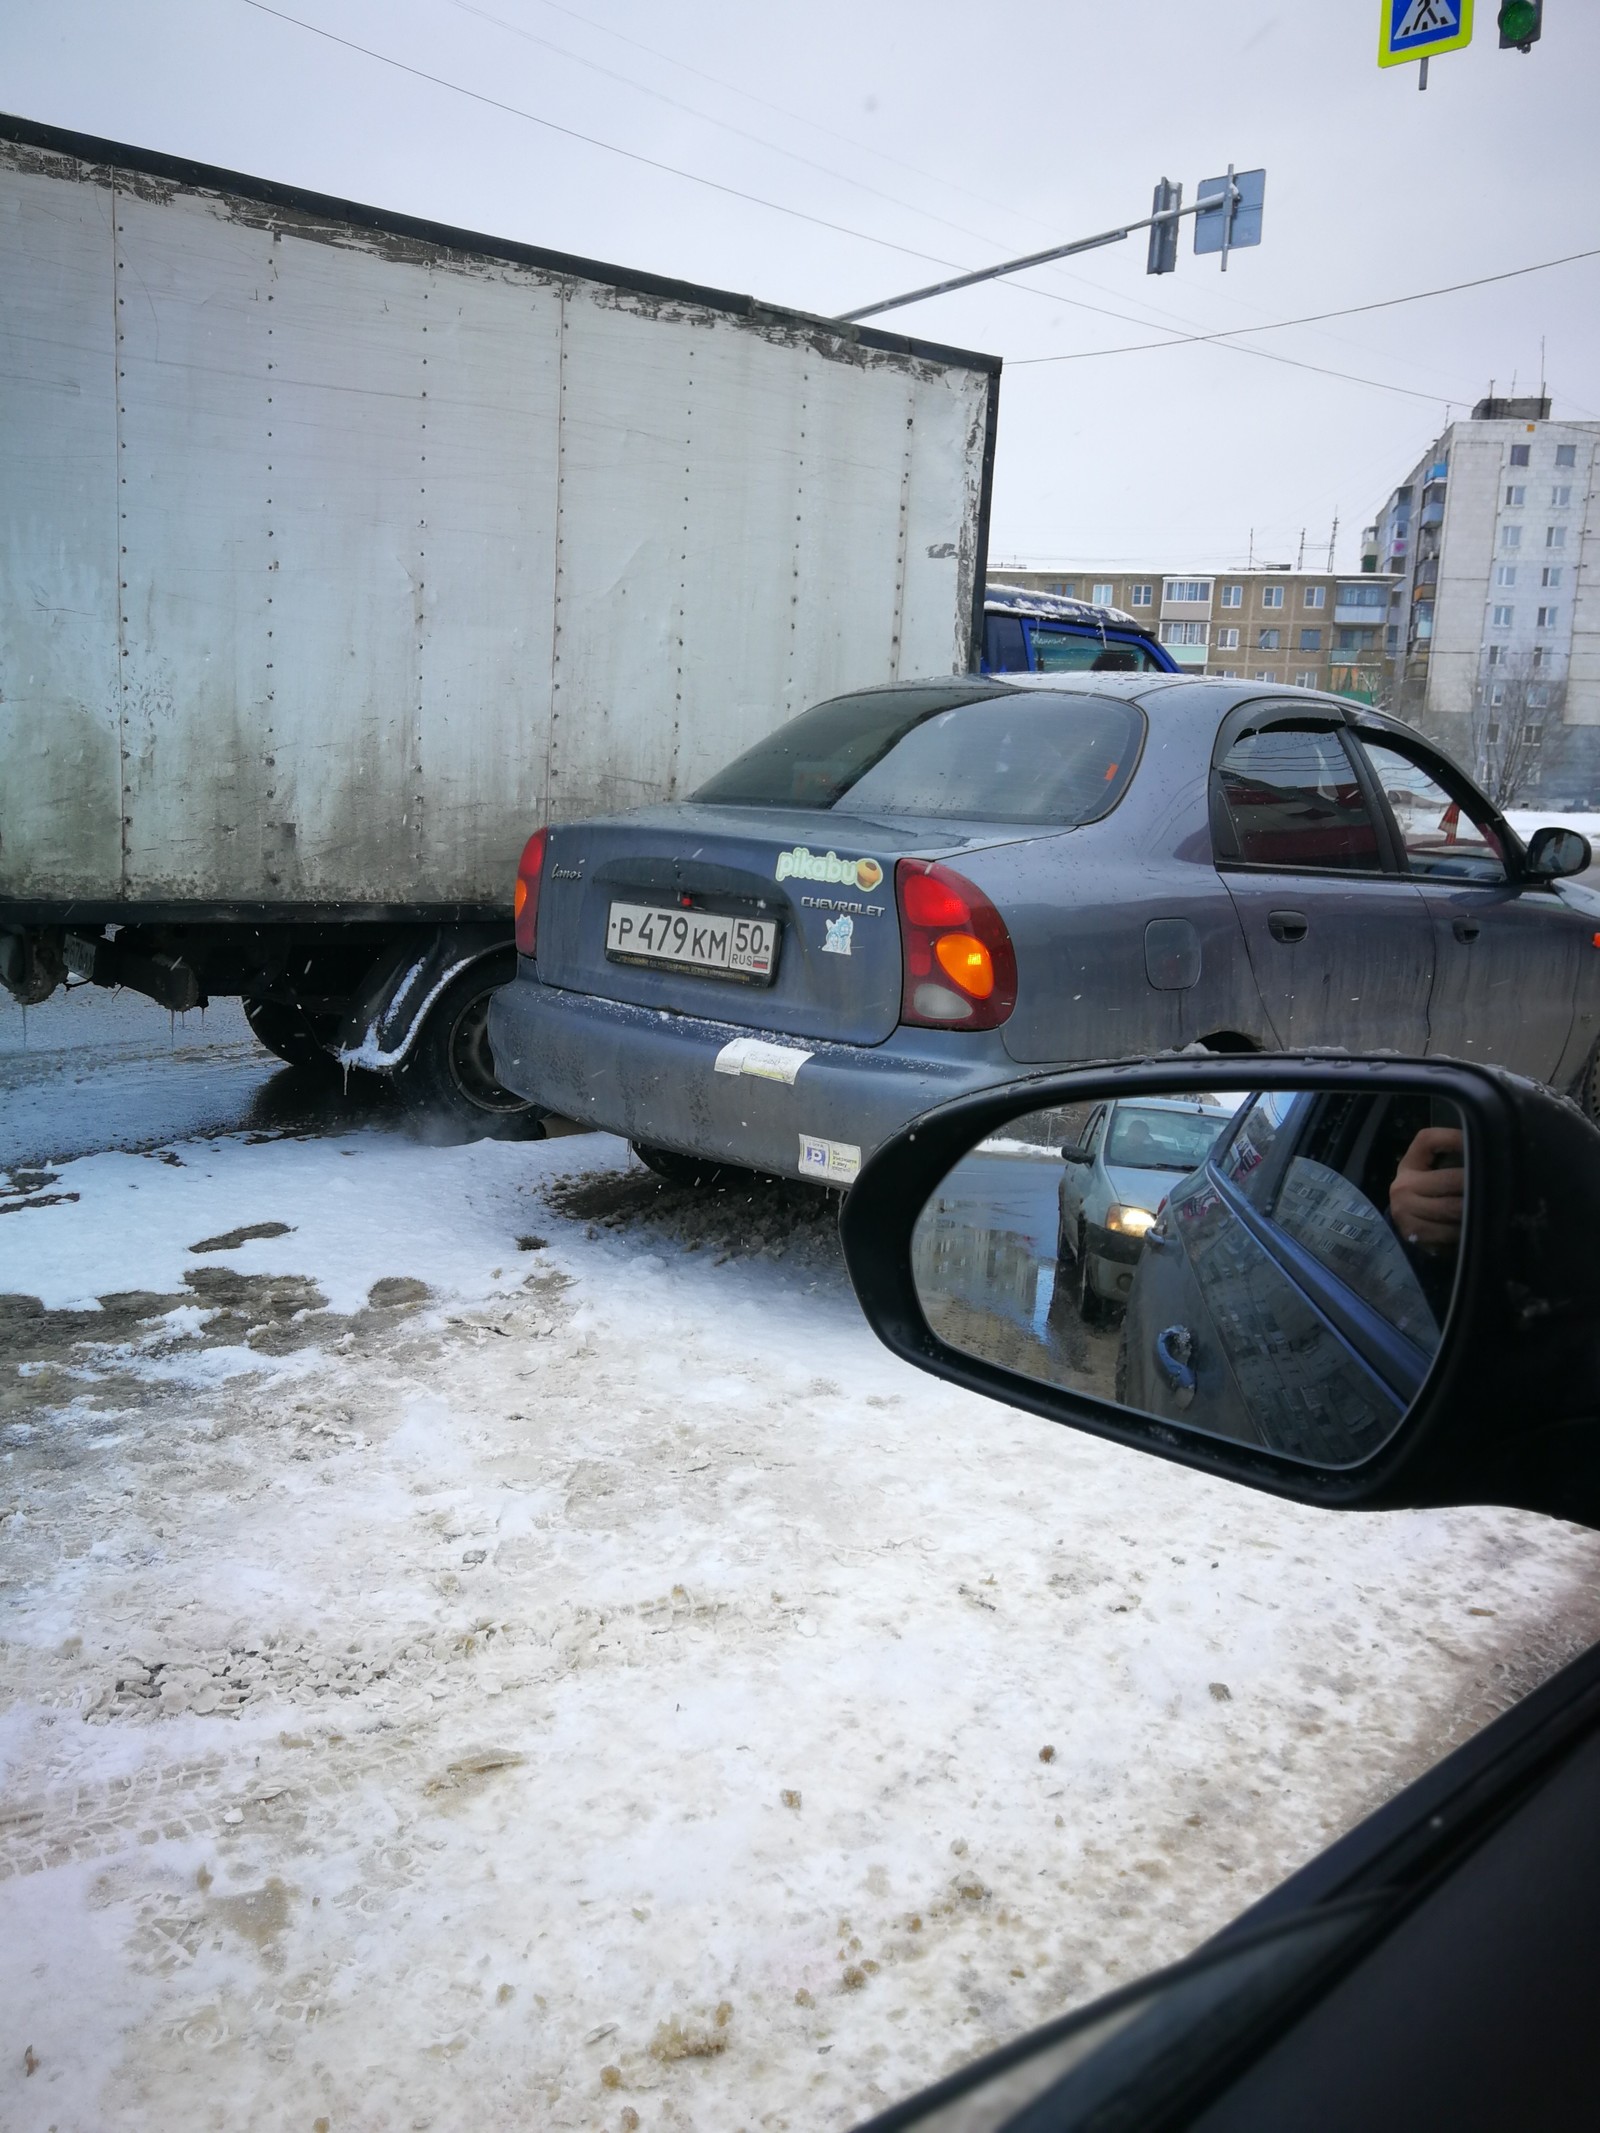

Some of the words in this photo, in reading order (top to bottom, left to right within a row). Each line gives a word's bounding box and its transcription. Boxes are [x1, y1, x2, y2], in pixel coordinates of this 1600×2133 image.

[777, 848, 857, 884] pikabu
[801, 896, 885, 917] CHEVROLET
[735, 922, 764, 955] 50
[731, 955, 753, 967] RUS
